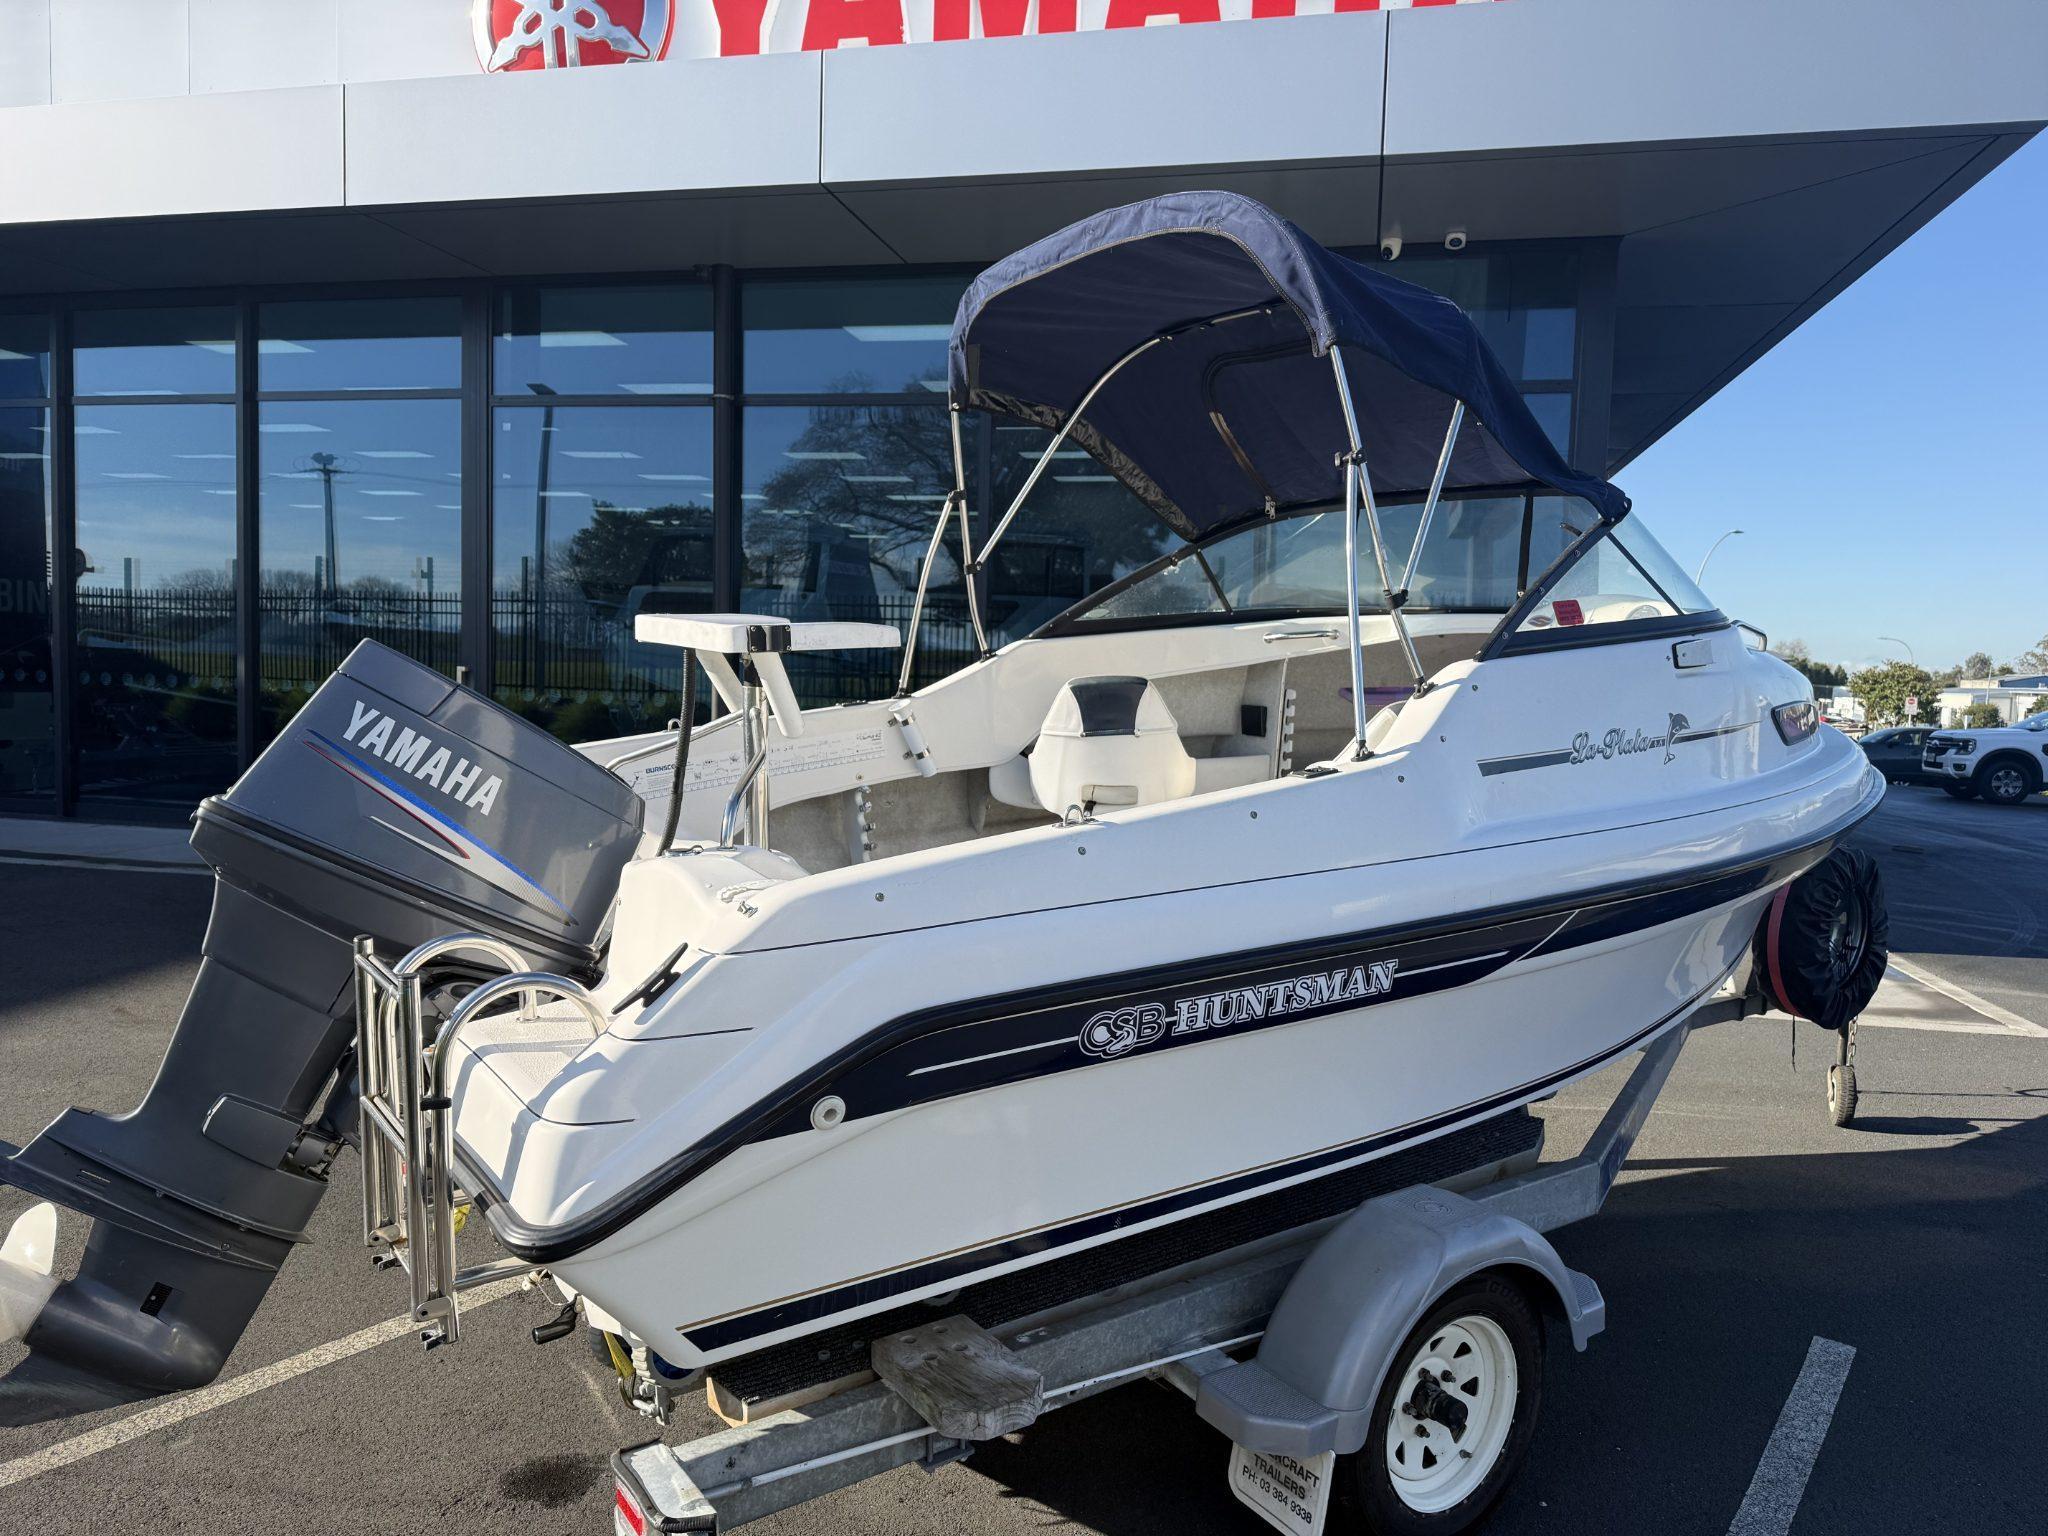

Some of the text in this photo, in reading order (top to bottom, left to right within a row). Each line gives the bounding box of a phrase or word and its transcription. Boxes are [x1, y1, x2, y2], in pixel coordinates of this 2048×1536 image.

[343, 700, 503, 816] YAMAHA
[1079, 959, 1398, 1058] CSB HUNTSMAN
[1242, 1465, 1312, 1524] PH: 03 384 9338
[1253, 1453, 1306, 1500] TRAILERS
